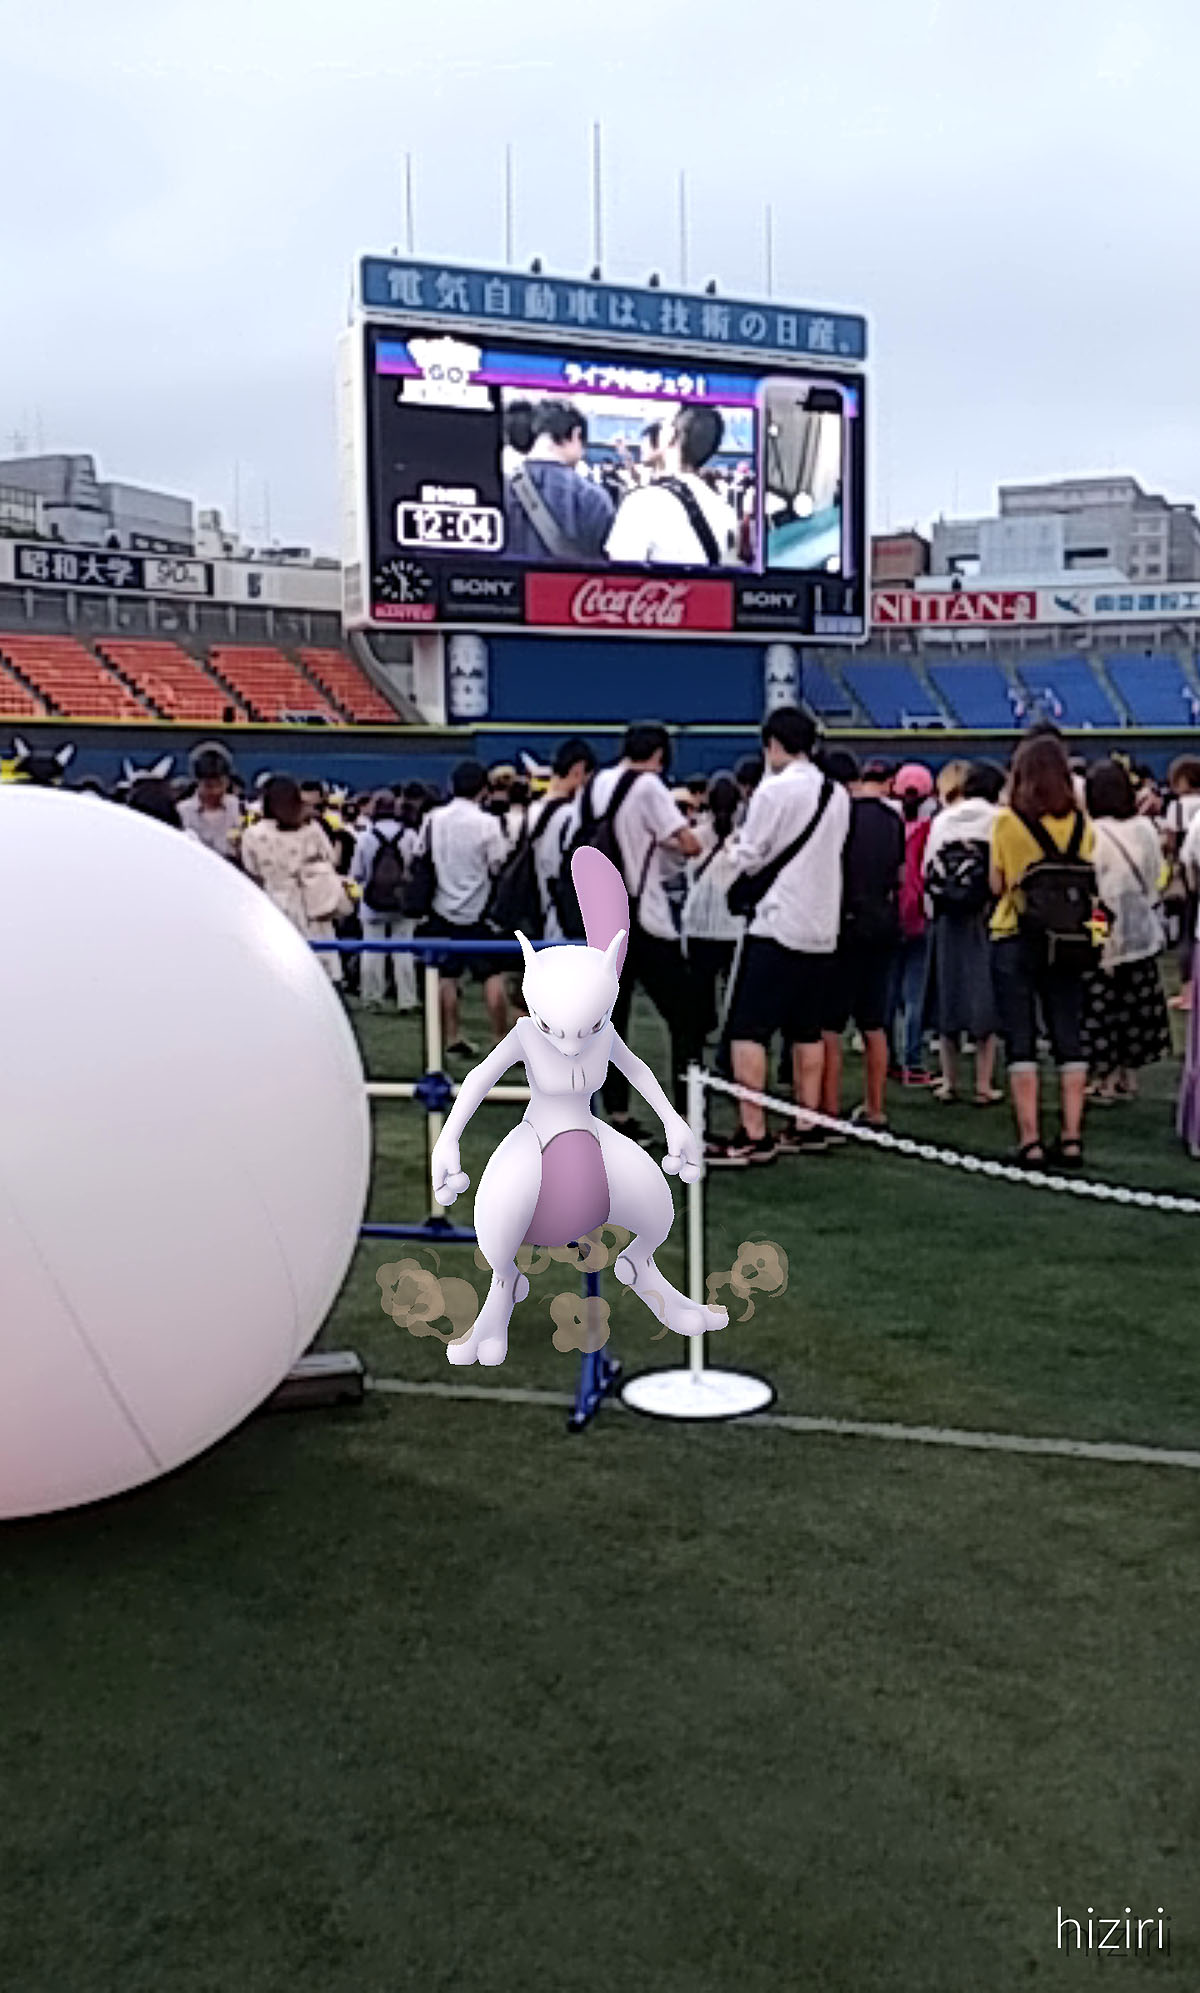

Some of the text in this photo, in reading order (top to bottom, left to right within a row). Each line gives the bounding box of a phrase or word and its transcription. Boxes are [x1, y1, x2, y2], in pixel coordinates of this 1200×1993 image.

[412, 508, 493, 545] 12:04
[20, 549, 134, 586] 昭和大学
[451, 578, 515, 597] SONY
[742, 590, 797, 608] SONY
